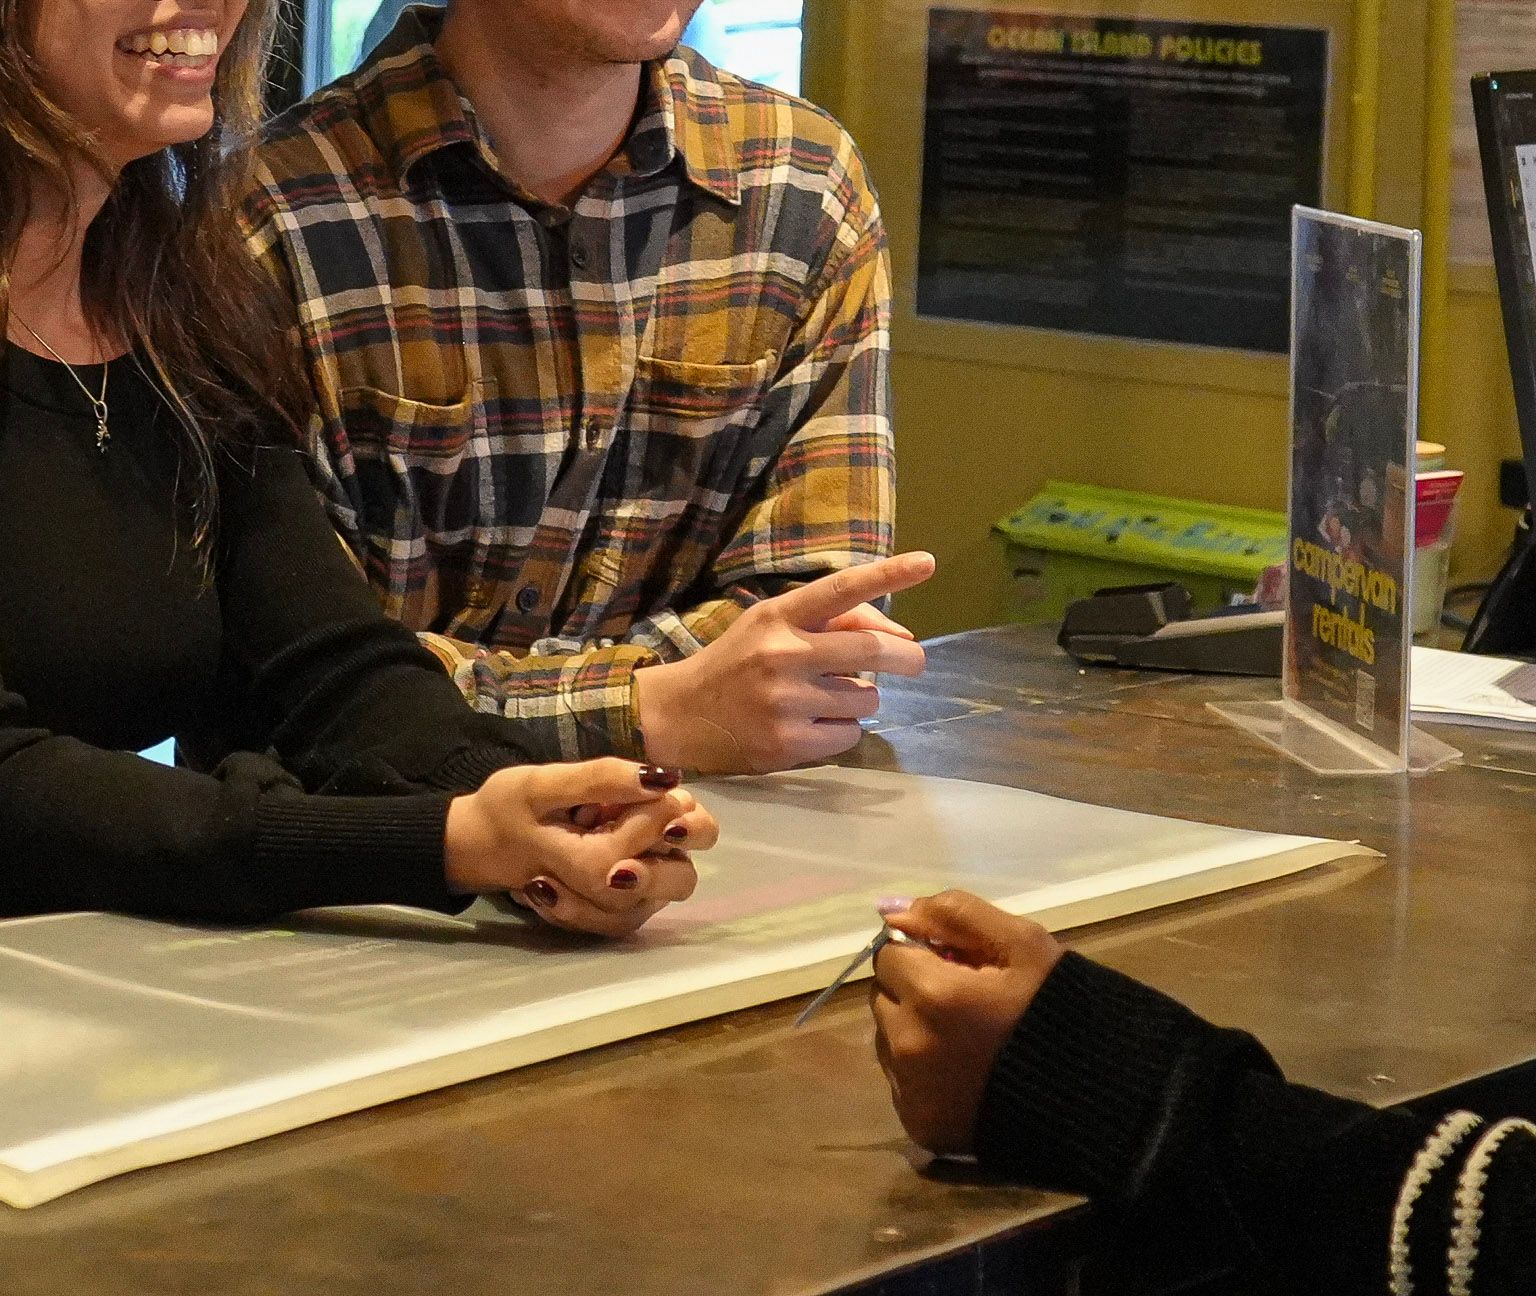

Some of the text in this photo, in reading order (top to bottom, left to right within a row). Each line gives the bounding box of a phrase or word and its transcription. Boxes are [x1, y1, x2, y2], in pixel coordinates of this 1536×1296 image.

[986, 27, 1262, 65] OCEAN ISLAND POLICIES
[1291, 538, 1397, 615] campervan
[1311, 597, 1376, 665] rentals
